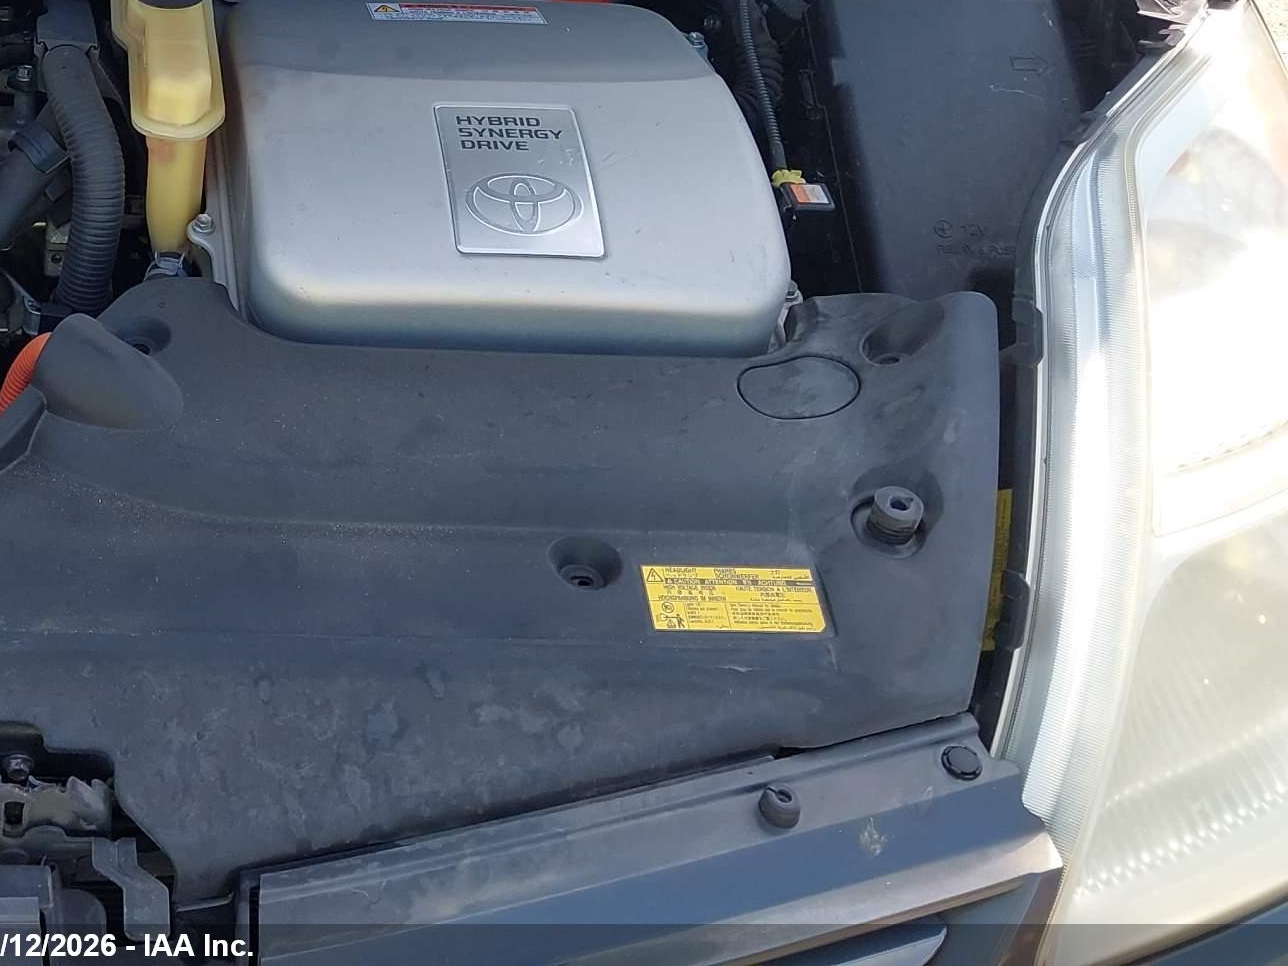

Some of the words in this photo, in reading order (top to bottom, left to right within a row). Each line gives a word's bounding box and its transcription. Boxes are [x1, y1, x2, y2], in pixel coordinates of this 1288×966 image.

[456, 115, 541, 127] HYBRID
[459, 127, 563, 140] SYNERGY
[461, 139, 529, 151] DRIVE
